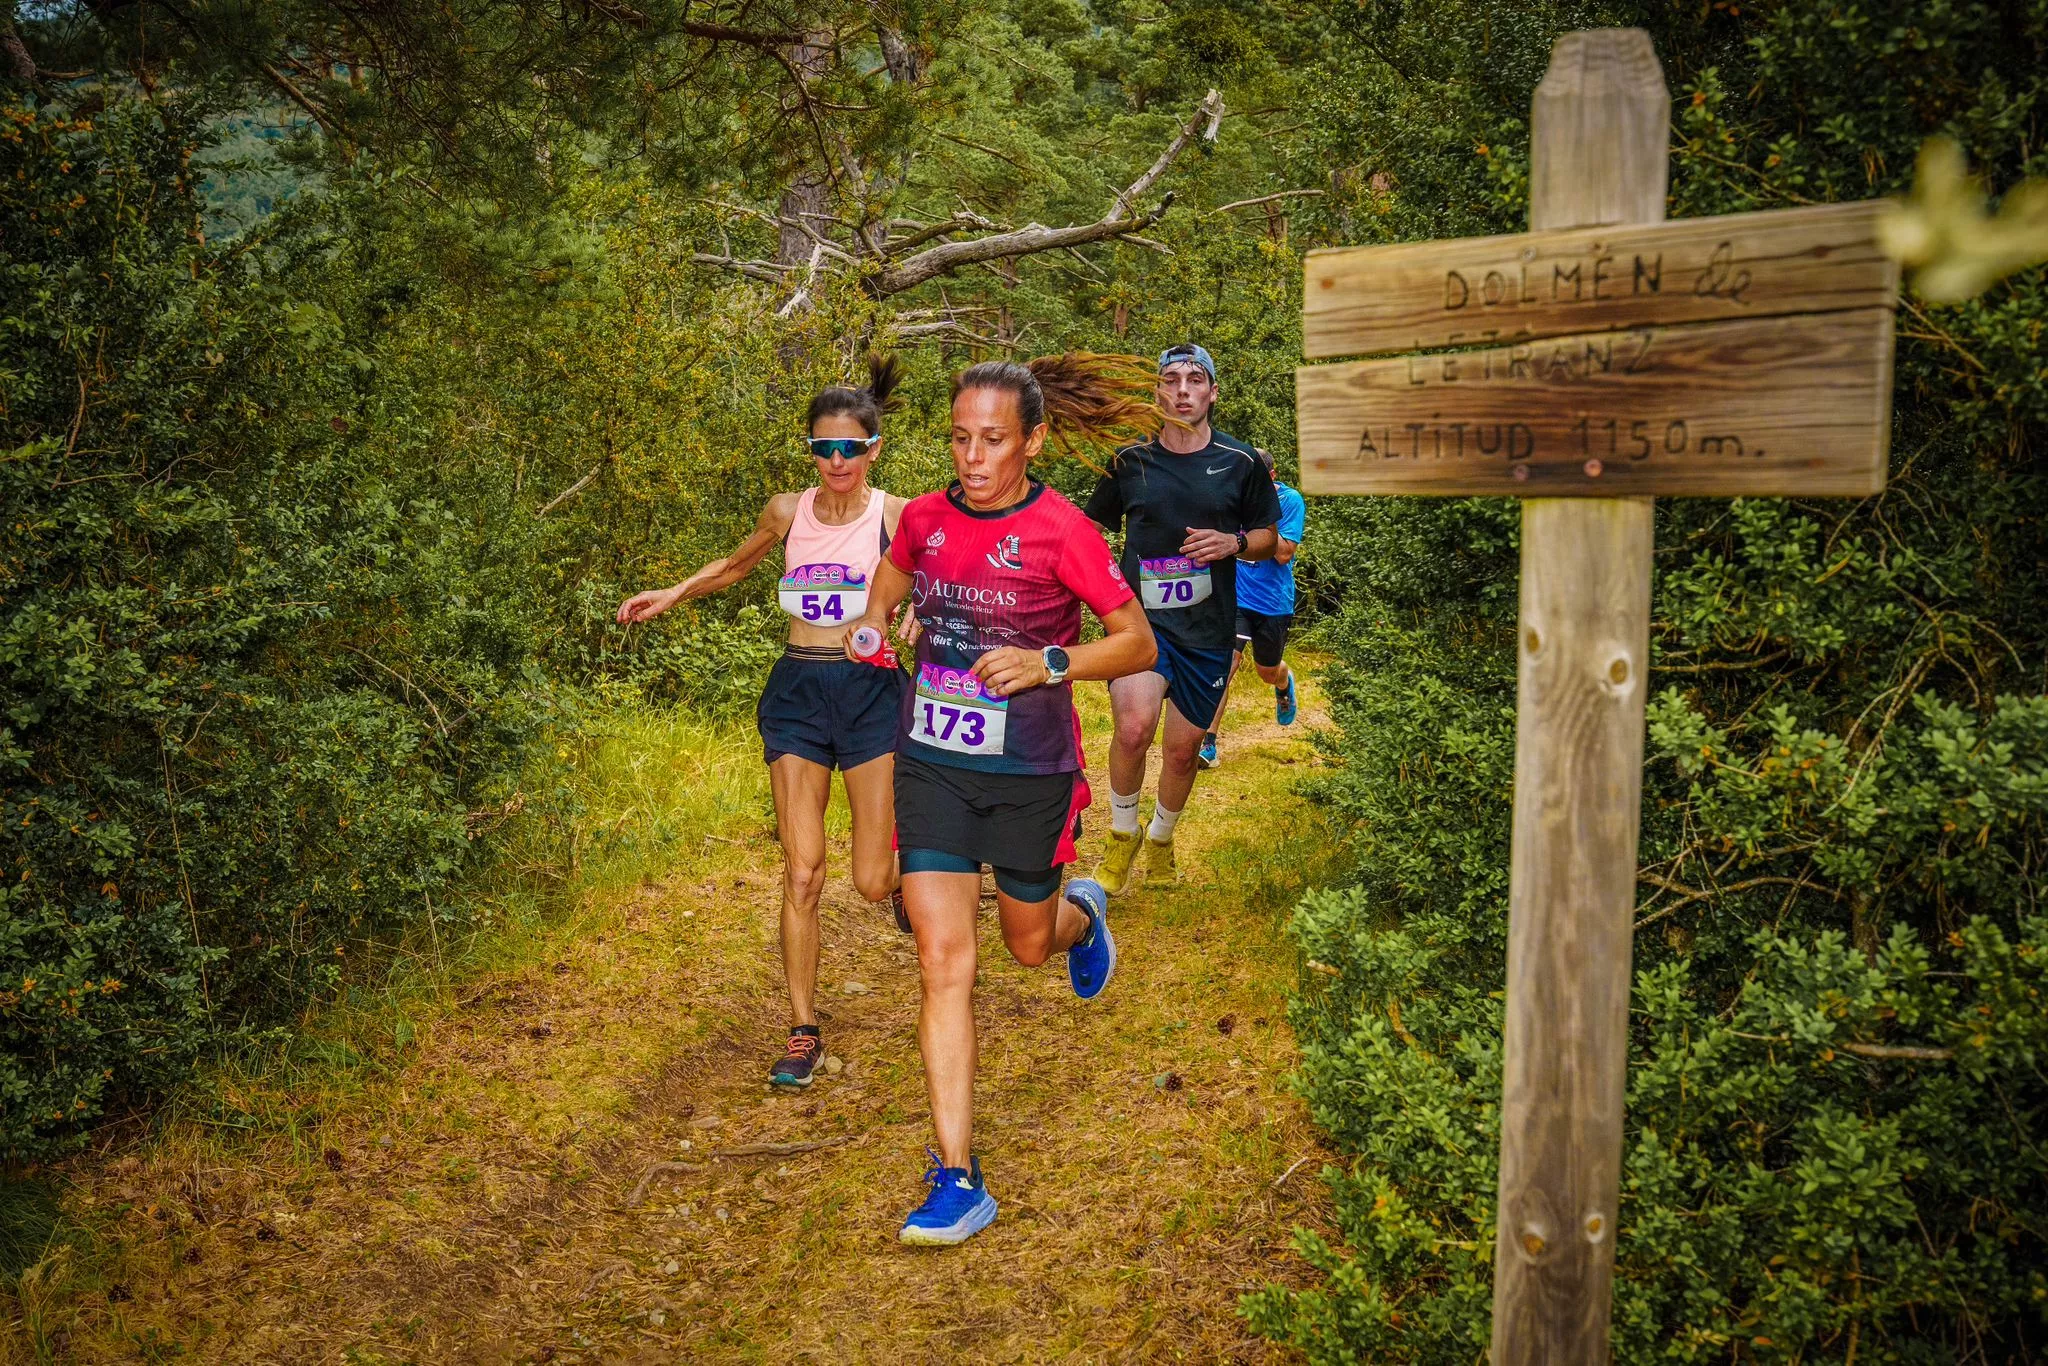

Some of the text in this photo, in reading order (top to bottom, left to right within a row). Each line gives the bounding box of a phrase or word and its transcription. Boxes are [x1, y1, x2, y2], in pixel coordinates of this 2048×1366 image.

[1445, 252, 1663, 311] DOLMEN
[1142, 557, 1192, 577] PACO
[801, 594, 844, 621] 54
[1158, 580, 1194, 604] 70
[918, 663, 982, 700] PACO
[923, 702, 986, 747] 173
